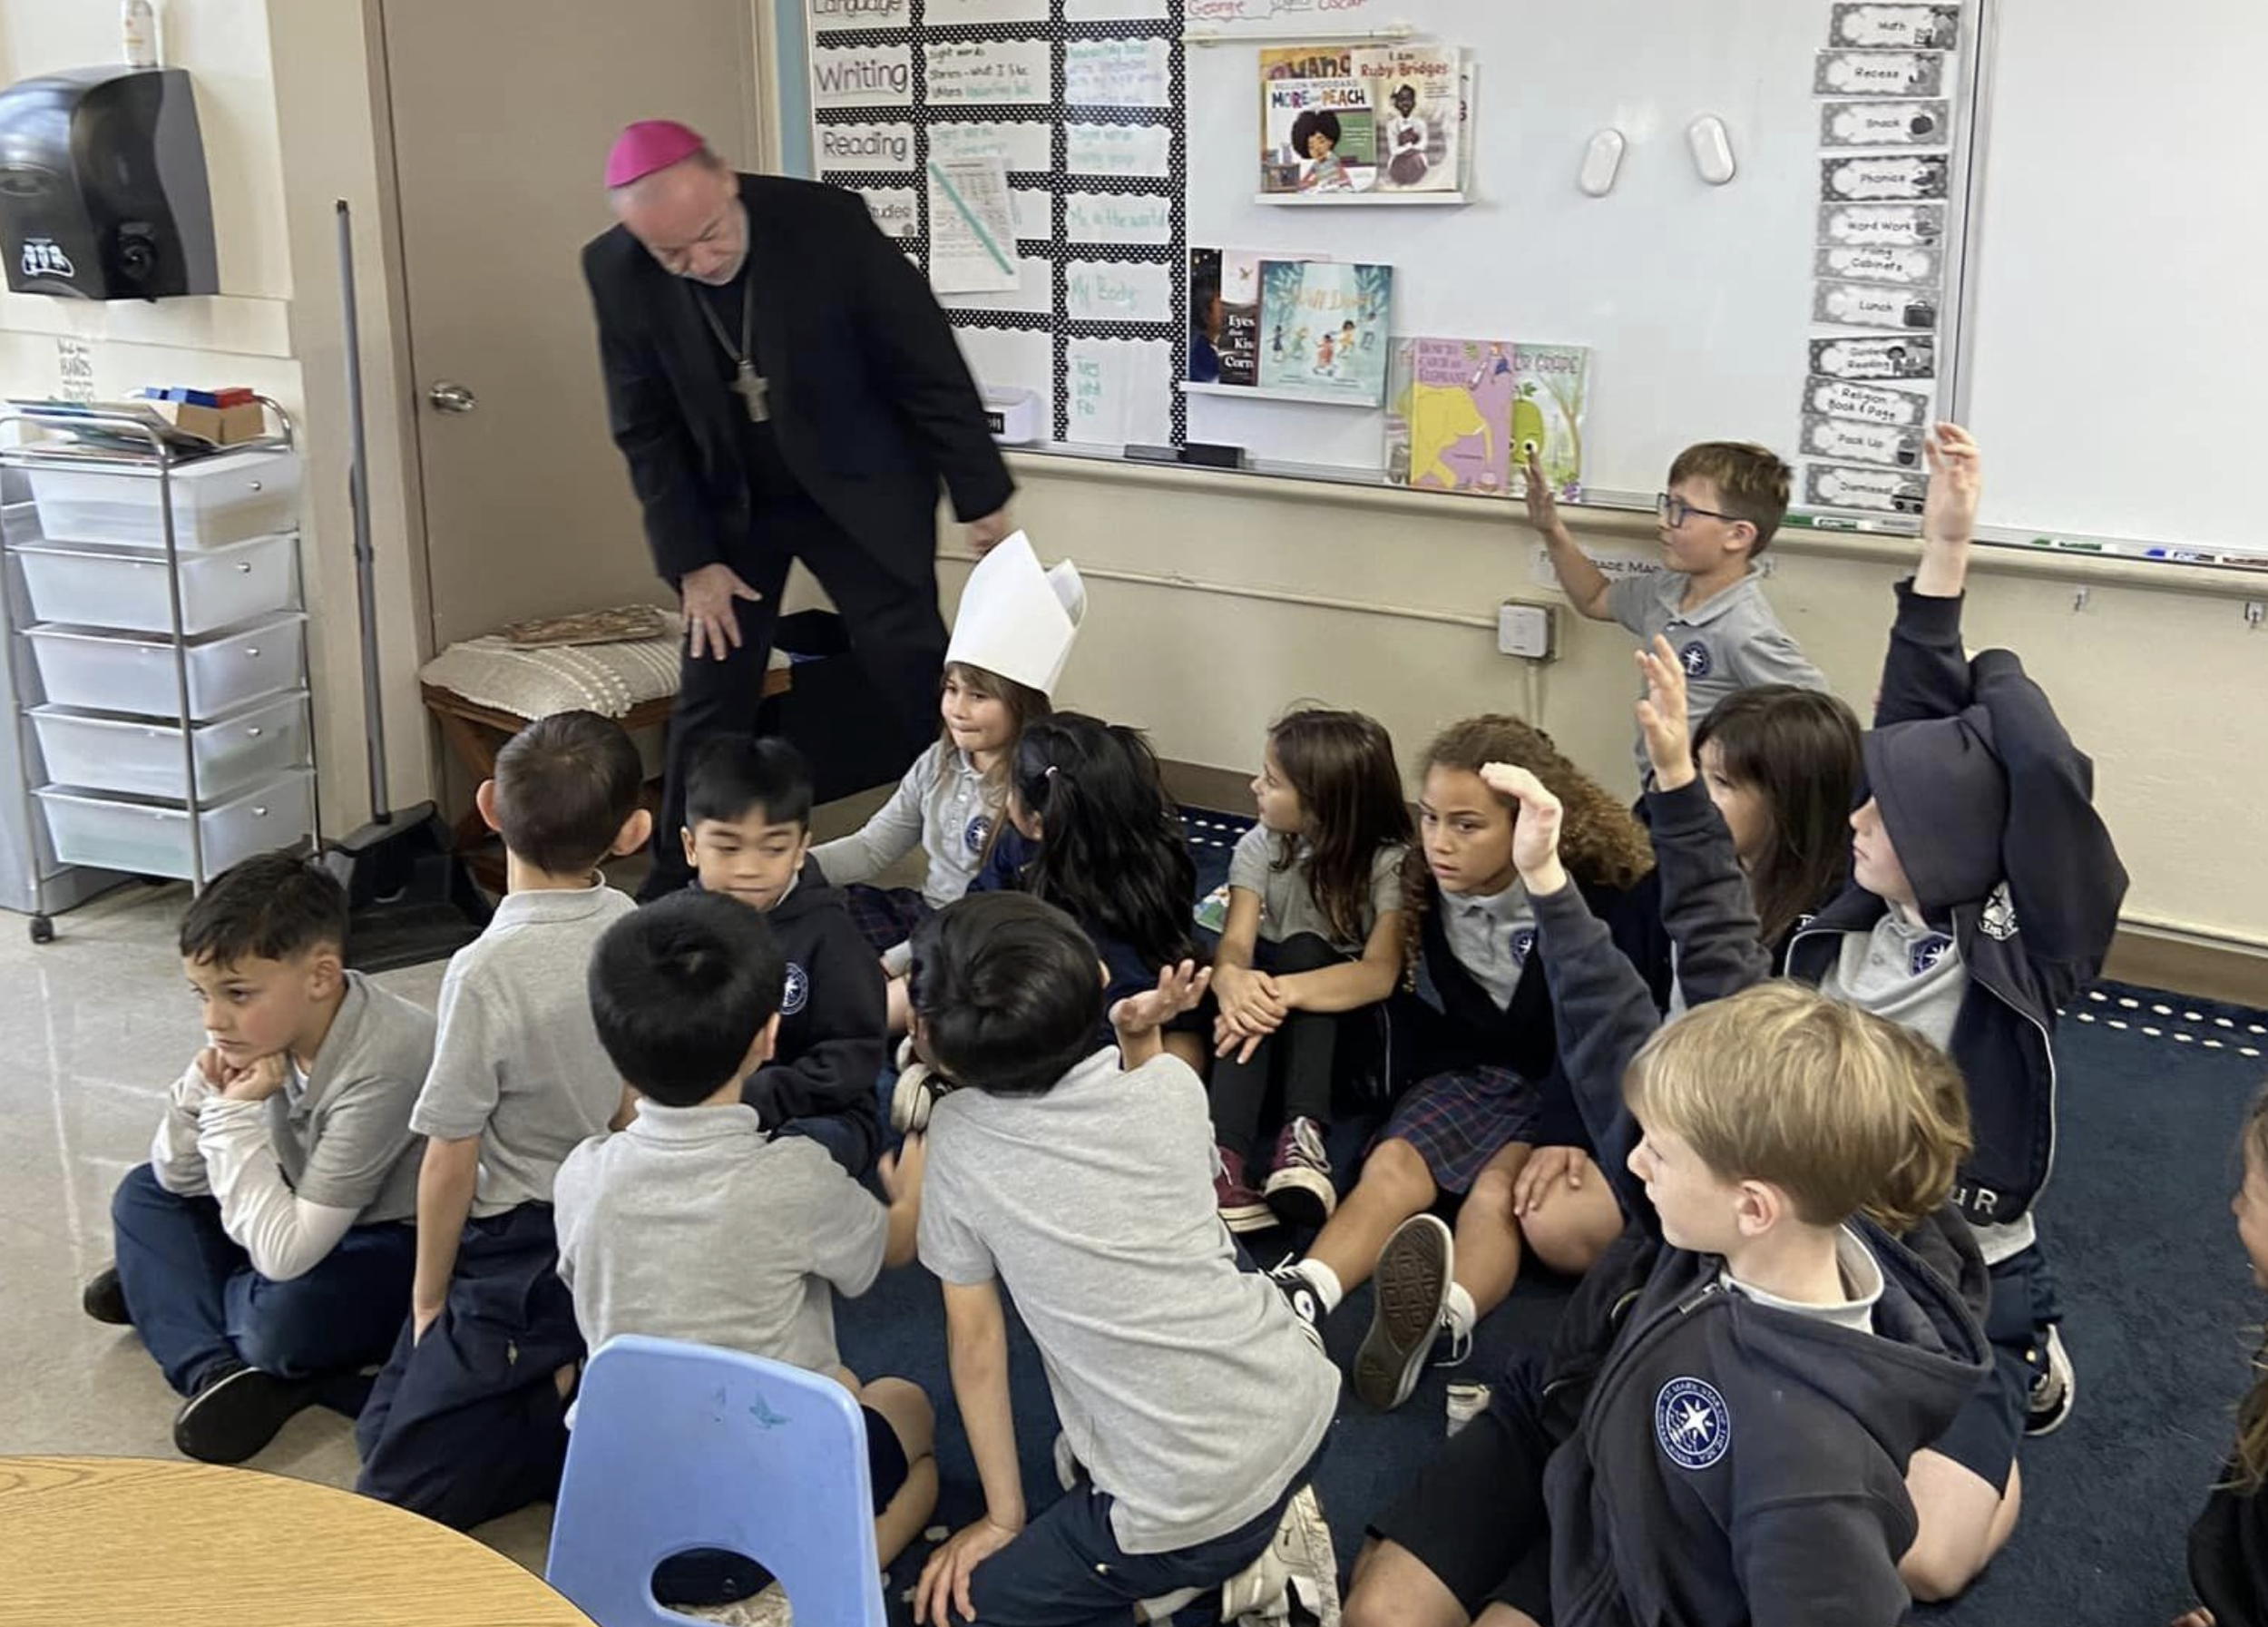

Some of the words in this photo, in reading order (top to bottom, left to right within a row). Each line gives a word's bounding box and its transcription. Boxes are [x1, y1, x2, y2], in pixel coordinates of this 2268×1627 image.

[815, 59, 908, 93] Writing
[1361, 63, 1394, 79] Ruby
[1399, 60, 1449, 77] Bridges
[1855, 67, 1899, 79] Recess
[1272, 91, 1310, 108] MORE
[1322, 89, 1365, 106] PEACH
[823, 132, 907, 162] Reading
[1861, 173, 1905, 183] Phonics
[1859, 300, 1893, 311] Lunch
[1228, 314, 1256, 328] Eyes
[1224, 356, 1255, 368] Corn
[1842, 387, 1887, 404] Religion
[1829, 399, 1855, 411] Book
[1837, 434, 1863, 445] Pack
